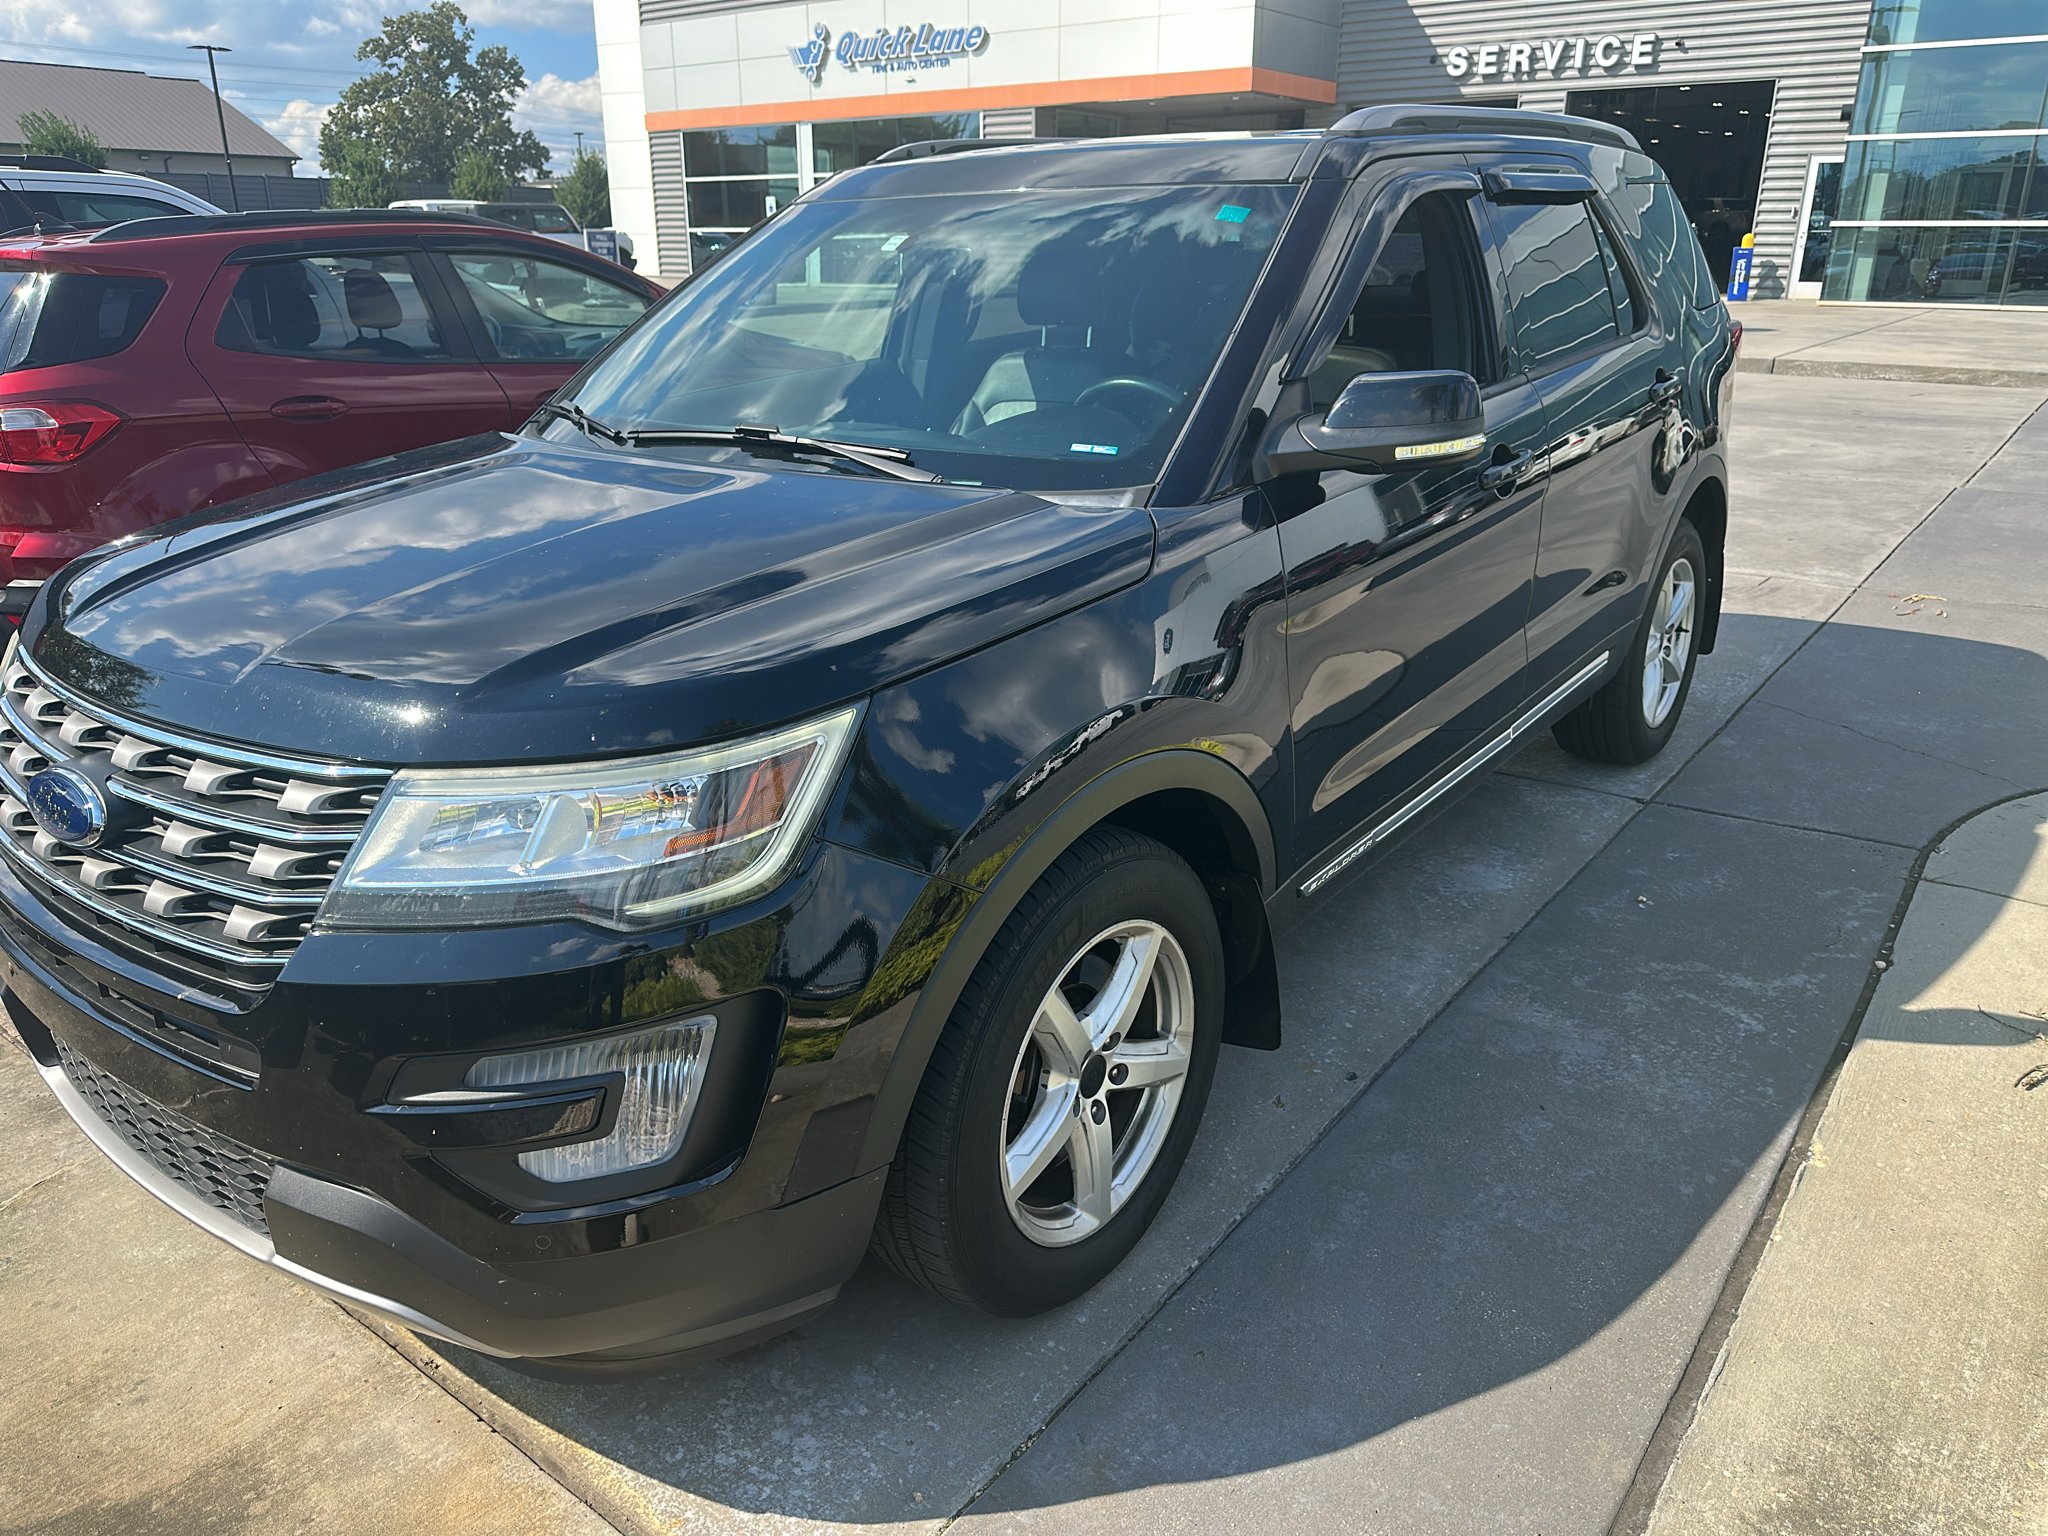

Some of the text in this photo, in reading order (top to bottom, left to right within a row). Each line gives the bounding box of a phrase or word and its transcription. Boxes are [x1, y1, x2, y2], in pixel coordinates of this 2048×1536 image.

[836, 23, 985, 66] Quick Lane
[1446, 33, 1657, 77] SERVICE
[1307, 839, 1373, 893] EXPLORER
